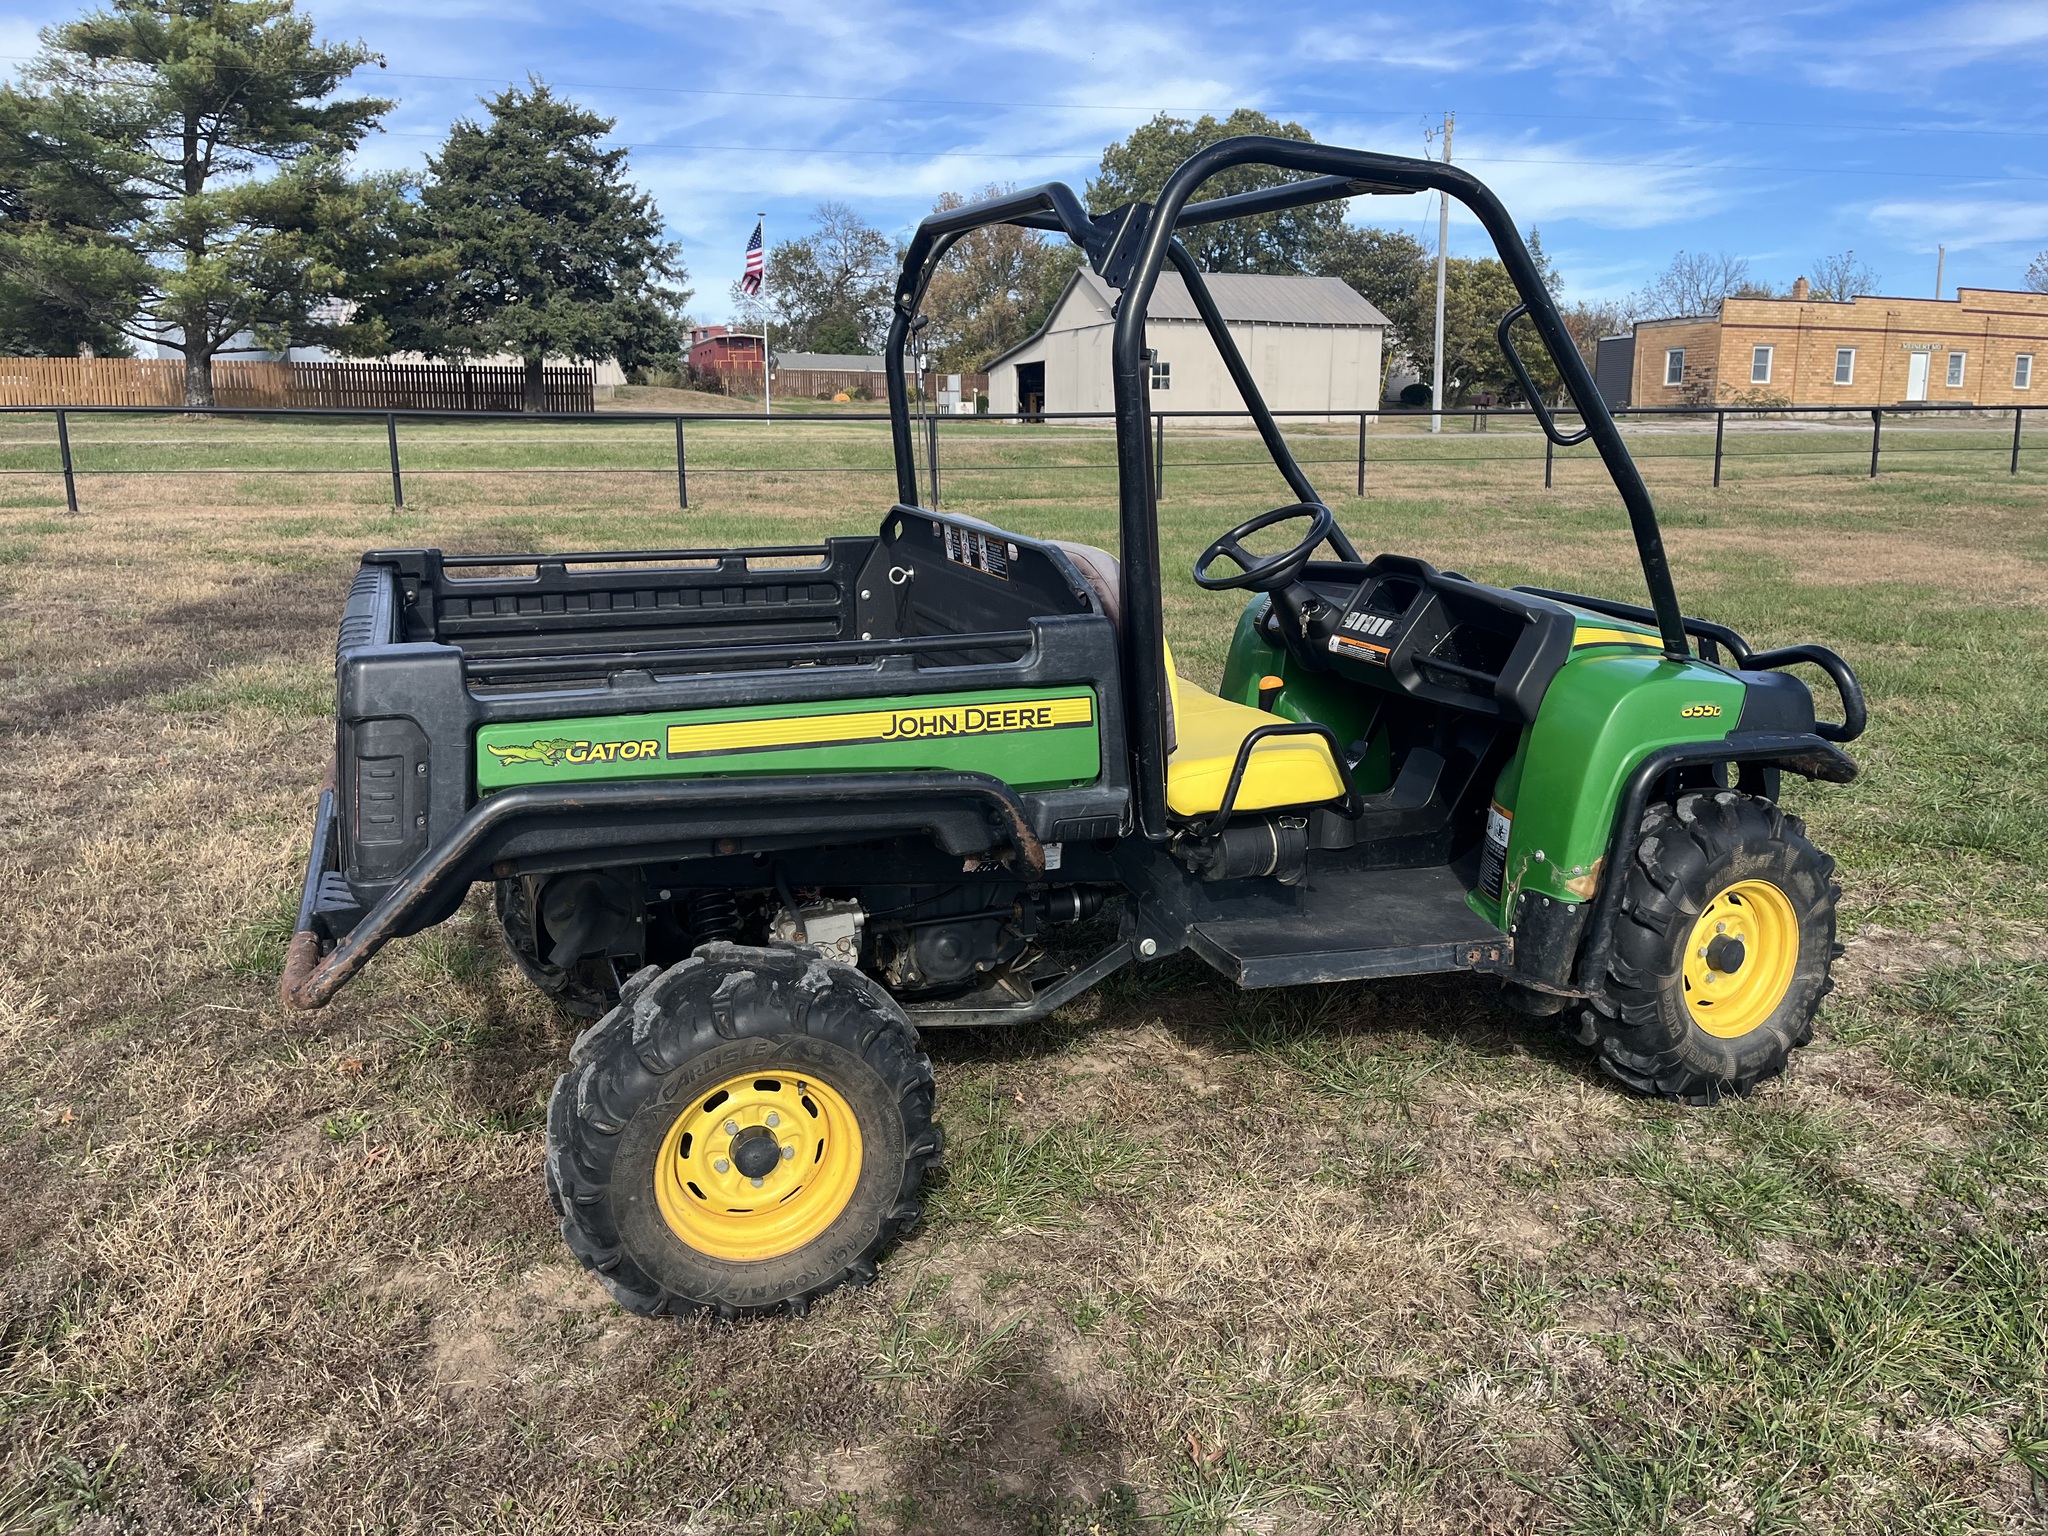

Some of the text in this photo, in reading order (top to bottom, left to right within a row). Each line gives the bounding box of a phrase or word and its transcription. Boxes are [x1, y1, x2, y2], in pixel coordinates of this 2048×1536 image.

[882, 707, 1052, 737] JOHN DEERE
[565, 739, 661, 766] GATOR
[1662, 989, 1682, 1039] KING
[662, 1041, 768, 1102] CARLISLE
[1677, 1037, 1727, 1074] POWER
[823, 1219, 877, 1270] BLACK
[769, 1264, 822, 1297] ROCK
